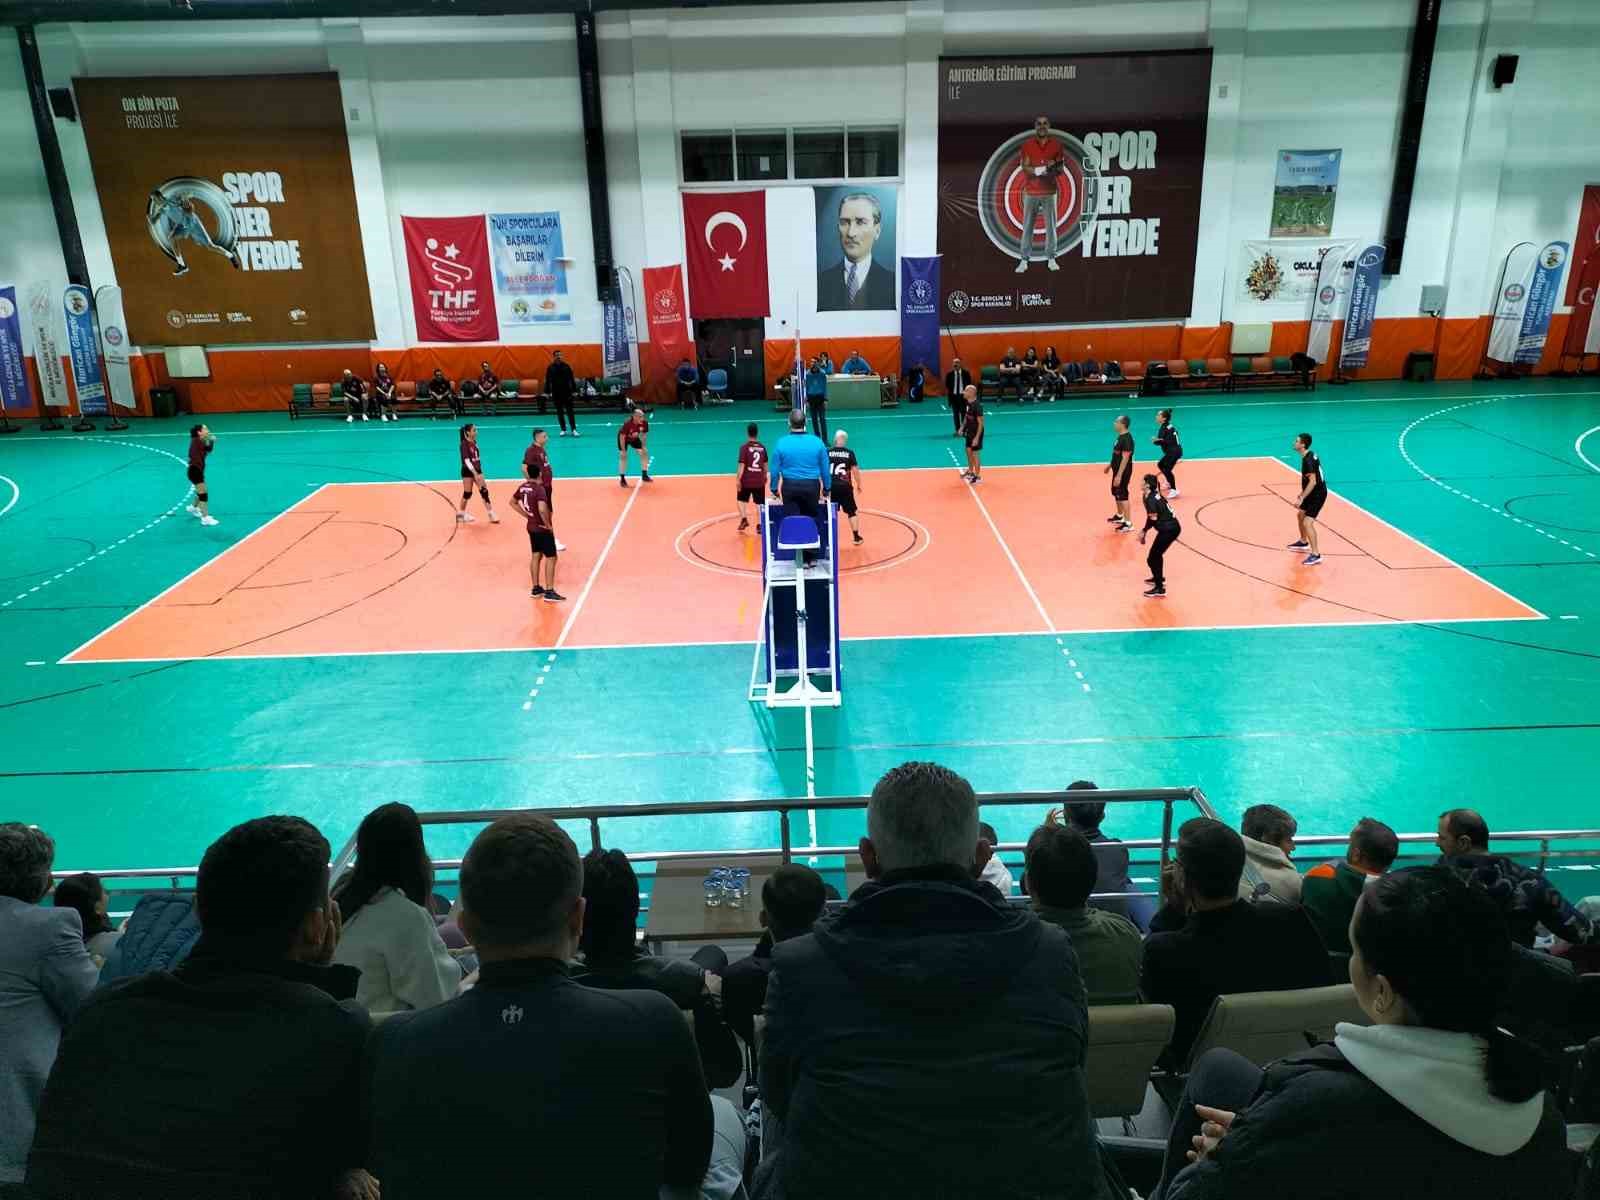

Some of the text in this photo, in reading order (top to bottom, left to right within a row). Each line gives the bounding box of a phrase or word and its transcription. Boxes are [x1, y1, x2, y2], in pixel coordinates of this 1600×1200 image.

[1028, 65, 1077, 80] PROGRAMI
[1083, 130, 1157, 170] SPOR
[222, 171, 286, 204] SPOR
[1081, 175, 1132, 215] HER
[1079, 218, 1161, 258] YERDE
[236, 239, 304, 272] YERDE
[428, 289, 477, 309] THF
[752, 451, 761, 468] 2
